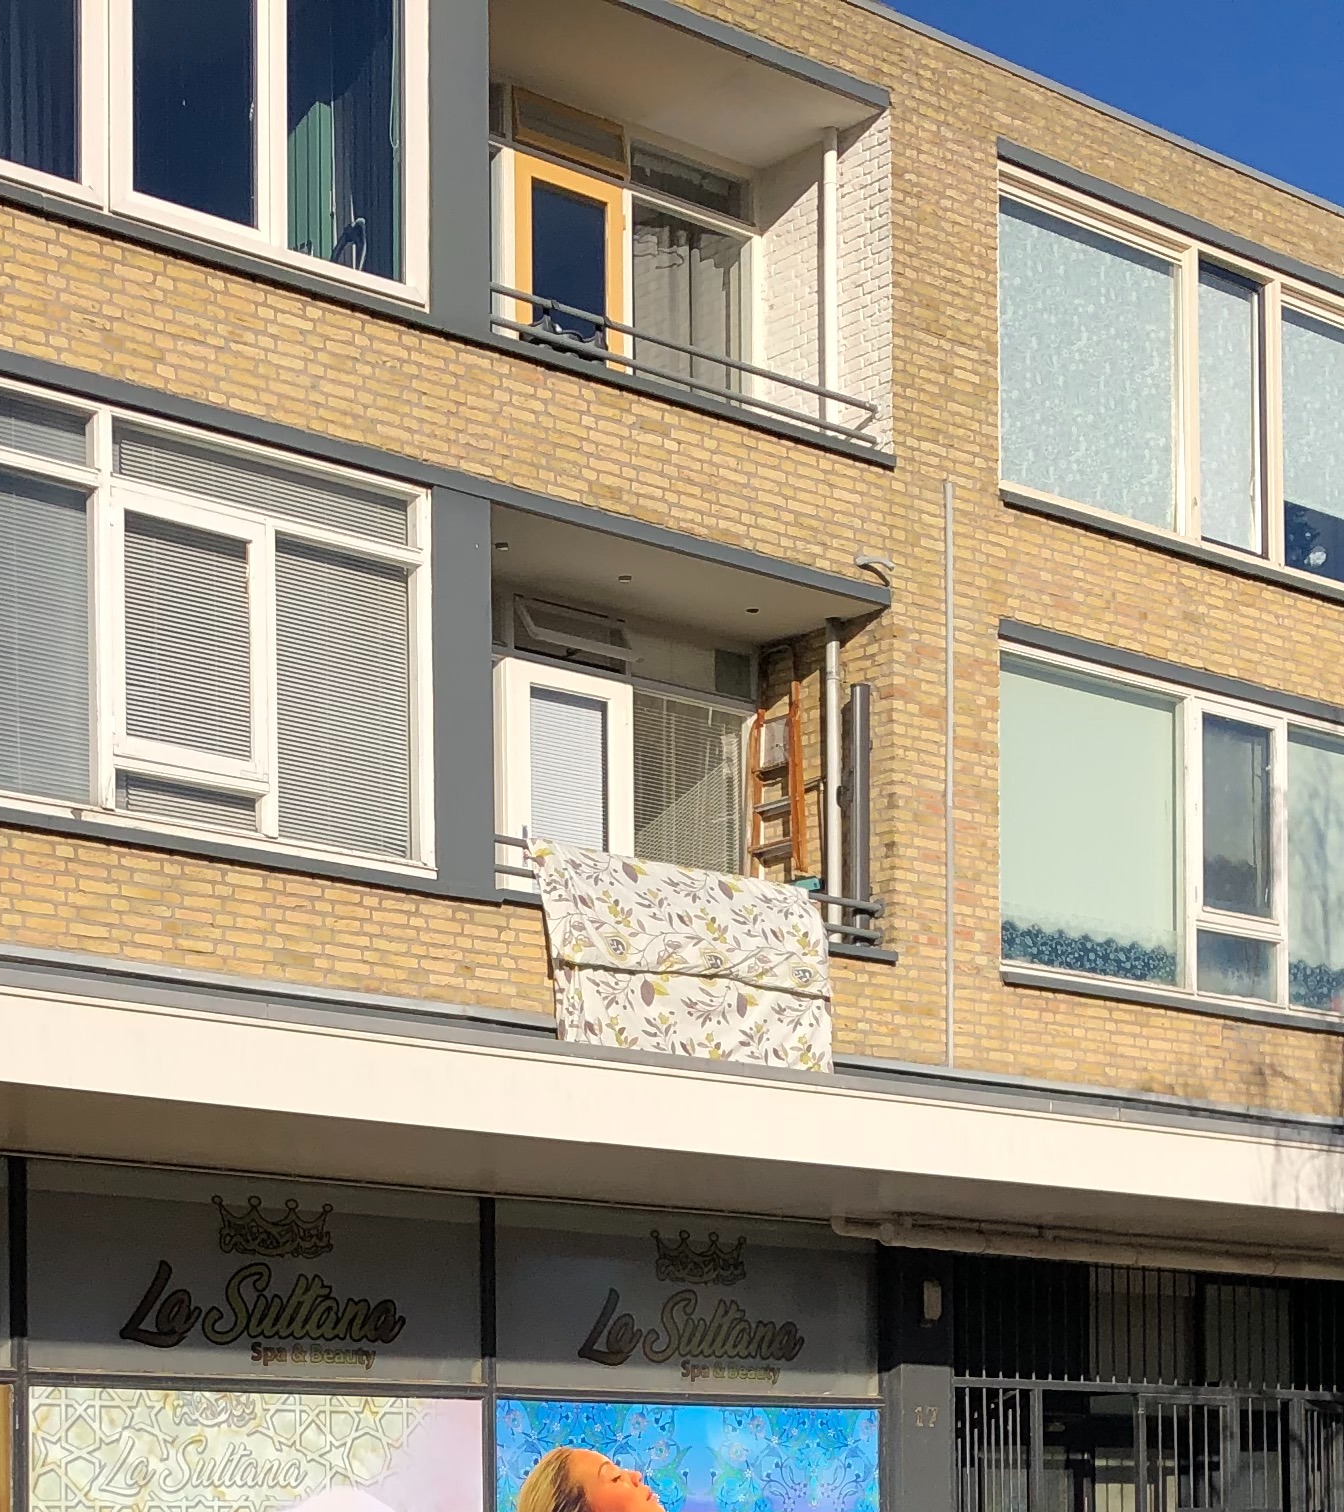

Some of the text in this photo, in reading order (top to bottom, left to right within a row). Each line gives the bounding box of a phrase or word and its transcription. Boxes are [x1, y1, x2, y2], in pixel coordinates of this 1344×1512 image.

[119, 1260, 406, 1348] La Sultana
[577, 1287, 806, 1367] La Sultana
[250, 1342, 377, 1371] Spa & Beauty
[680, 1359, 709, 1383] Spa
[727, 1362, 782, 1385] Beauty
[914, 1406, 938, 1428] 17
[98, 1430, 309, 1496] La Sultana
